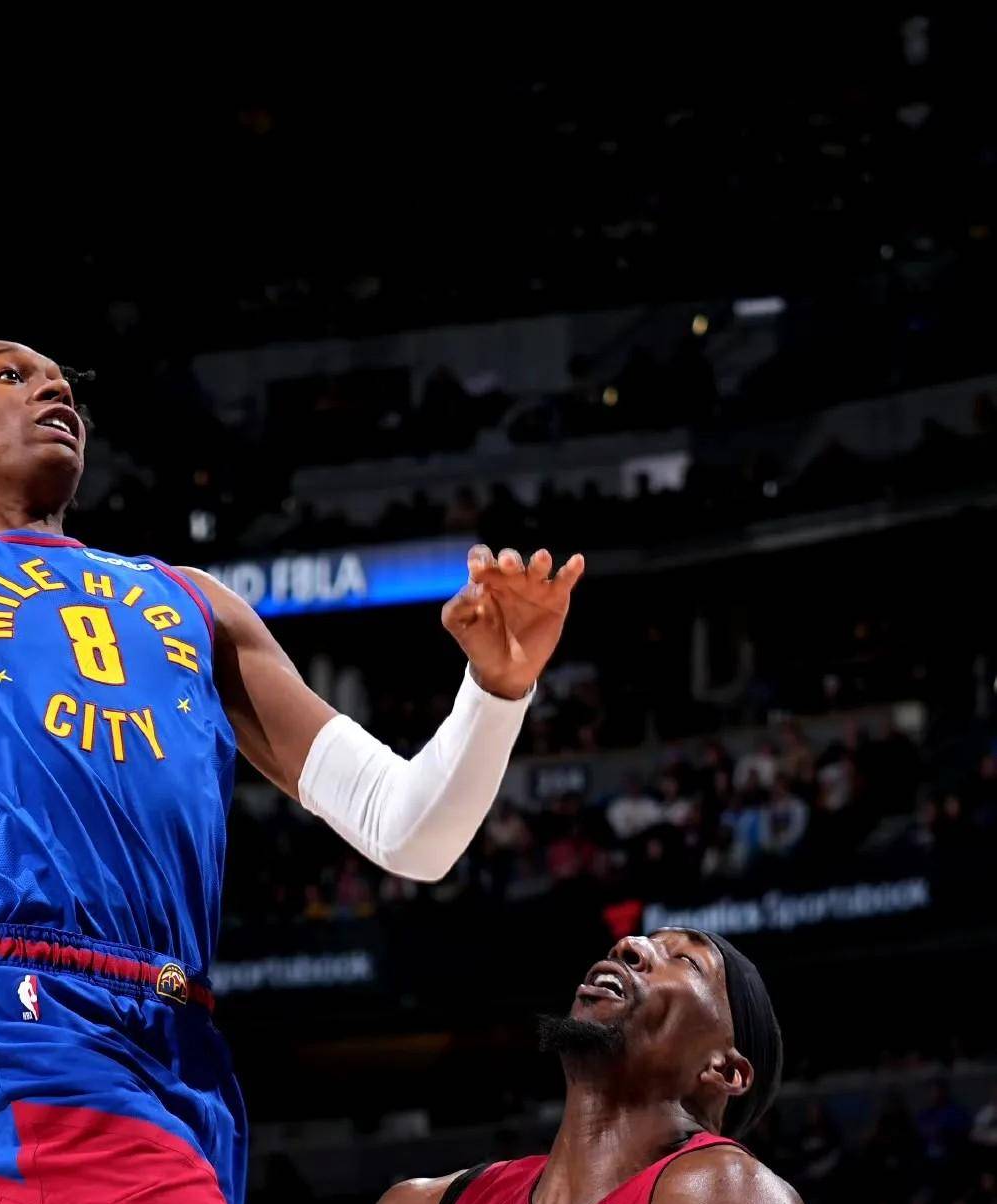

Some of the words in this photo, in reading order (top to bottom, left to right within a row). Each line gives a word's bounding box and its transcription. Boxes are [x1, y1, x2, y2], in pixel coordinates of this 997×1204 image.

[59, 604, 126, 686] 8
[82, 571, 199, 673] HIGH
[44, 693, 165, 762] CITY
